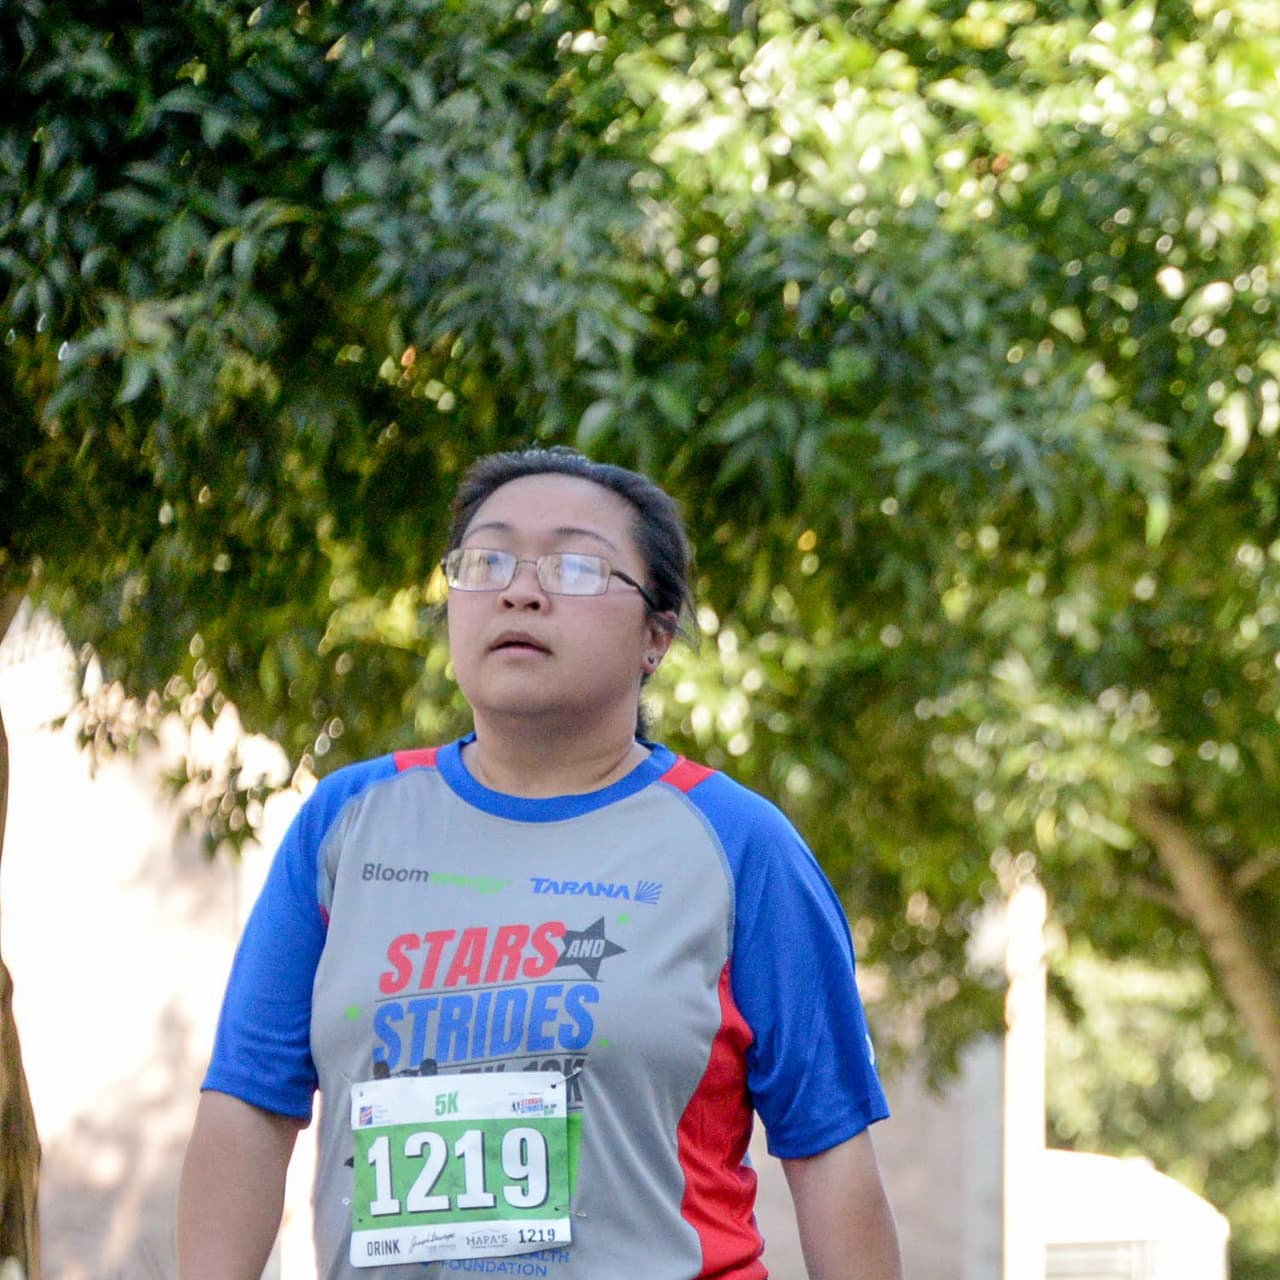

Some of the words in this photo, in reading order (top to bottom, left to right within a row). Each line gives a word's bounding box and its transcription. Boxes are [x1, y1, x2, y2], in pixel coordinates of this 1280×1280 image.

[530, 877, 630, 900] TARANA
[379, 921, 566, 995] STARS
[567, 938, 606, 959] AND
[372, 983, 600, 1073] STRIDES
[434, 1091, 459, 1116] 5K
[367, 1127, 549, 1217] 1219
[366, 1239, 401, 1257] DRINK
[518, 1228, 556, 1244] 1219
